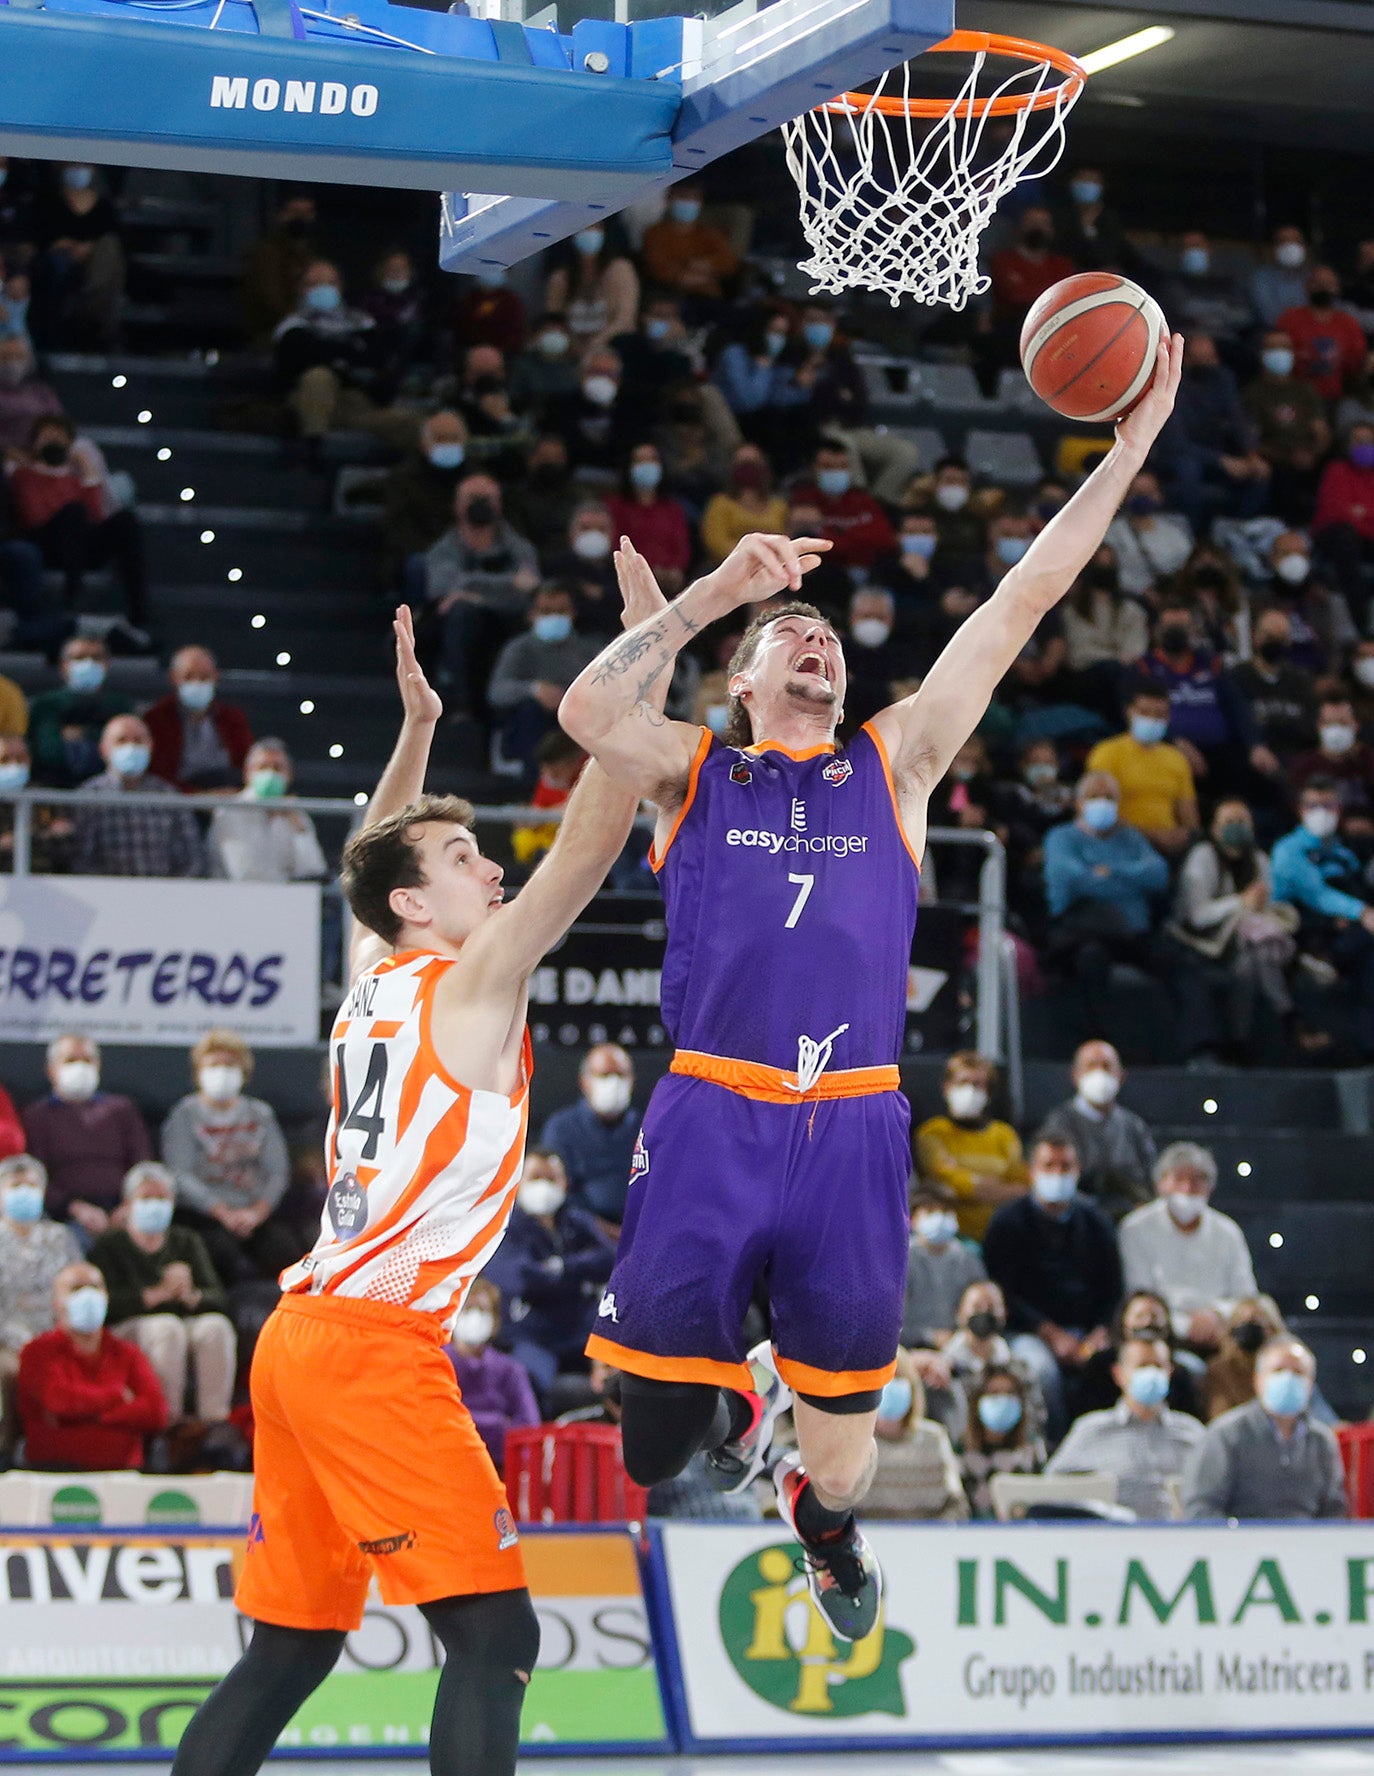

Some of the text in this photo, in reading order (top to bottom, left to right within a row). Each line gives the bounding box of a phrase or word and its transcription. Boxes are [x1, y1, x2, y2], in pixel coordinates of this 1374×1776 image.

[210, 76, 379, 117] MONDO
[726, 828, 869, 858] easycharger
[784, 872, 815, 929] 7
[336, 1042, 389, 1160] 14
[964, 1654, 1055, 1709] Grupo
[1069, 1651, 1203, 1695] Industrial
[1218, 1649, 1350, 1694] Matricera
